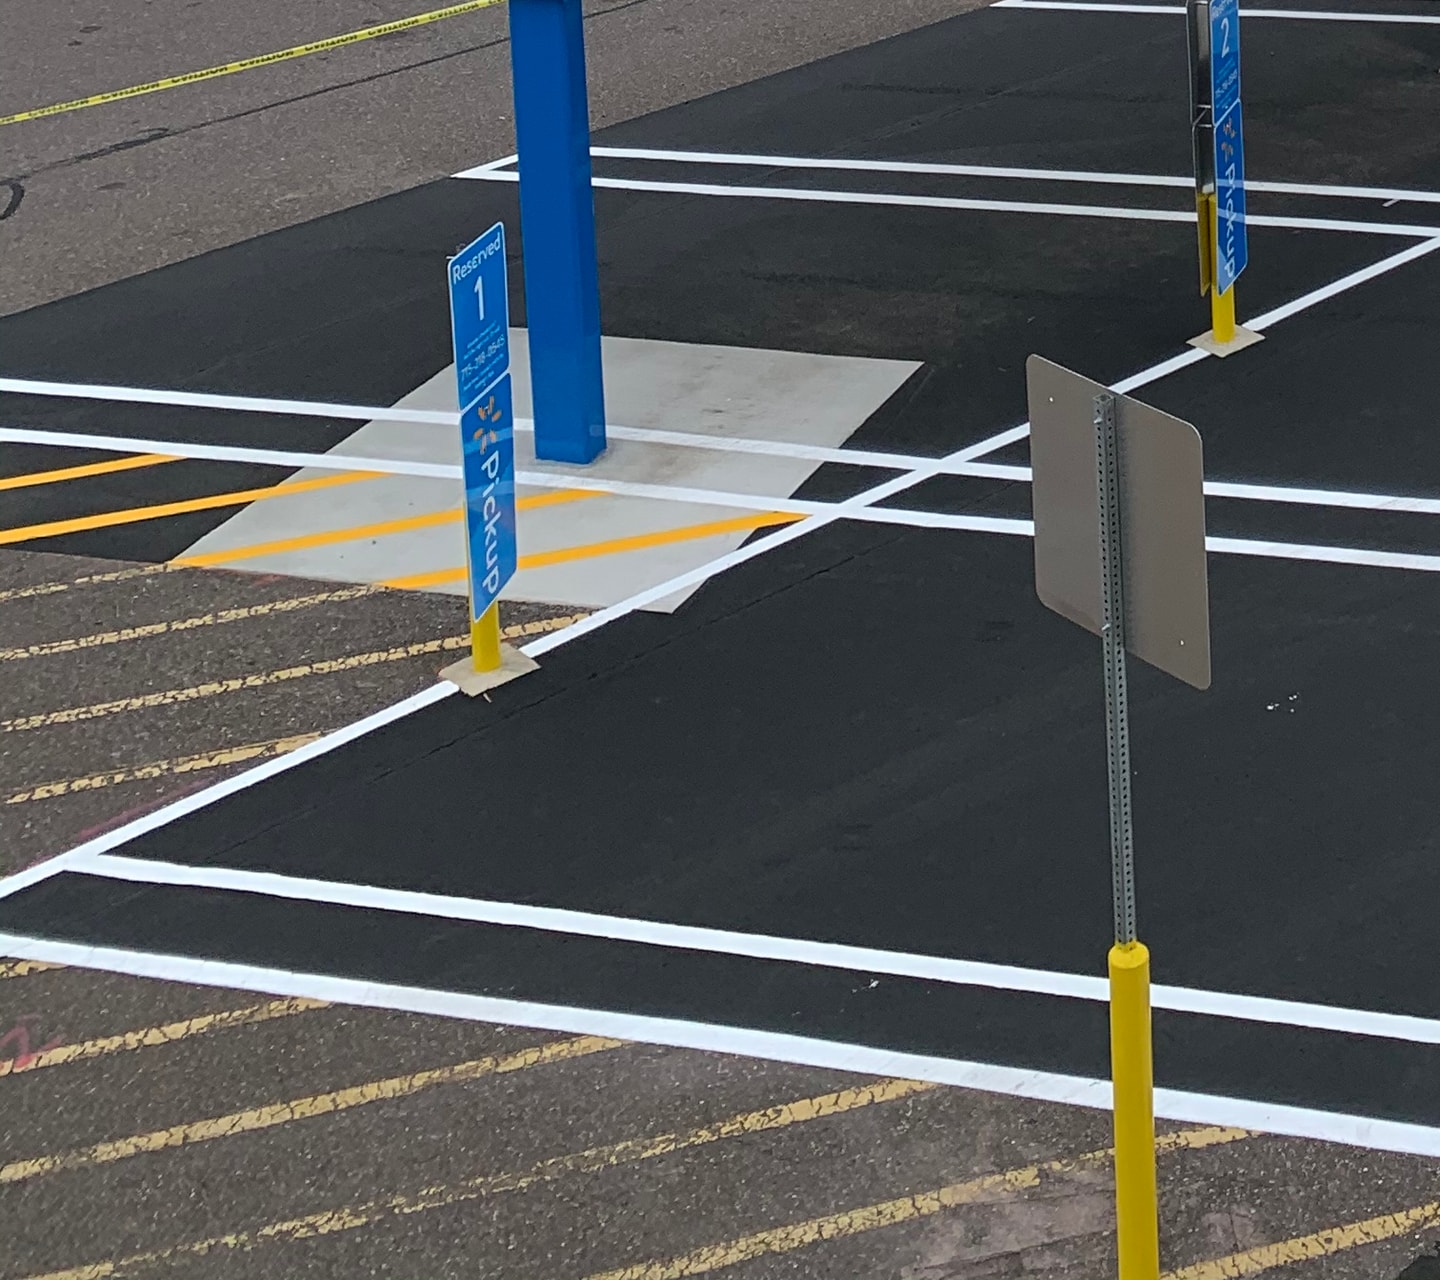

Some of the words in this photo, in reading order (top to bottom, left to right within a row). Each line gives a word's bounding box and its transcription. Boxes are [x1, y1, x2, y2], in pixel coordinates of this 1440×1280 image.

[1221, 17, 1230, 58] 2
[1224, 162, 1236, 278] Pickup
[452, 232, 501, 285] Reserved
[474, 275, 485, 321] 1
[481, 450, 501, 594] Pickup
